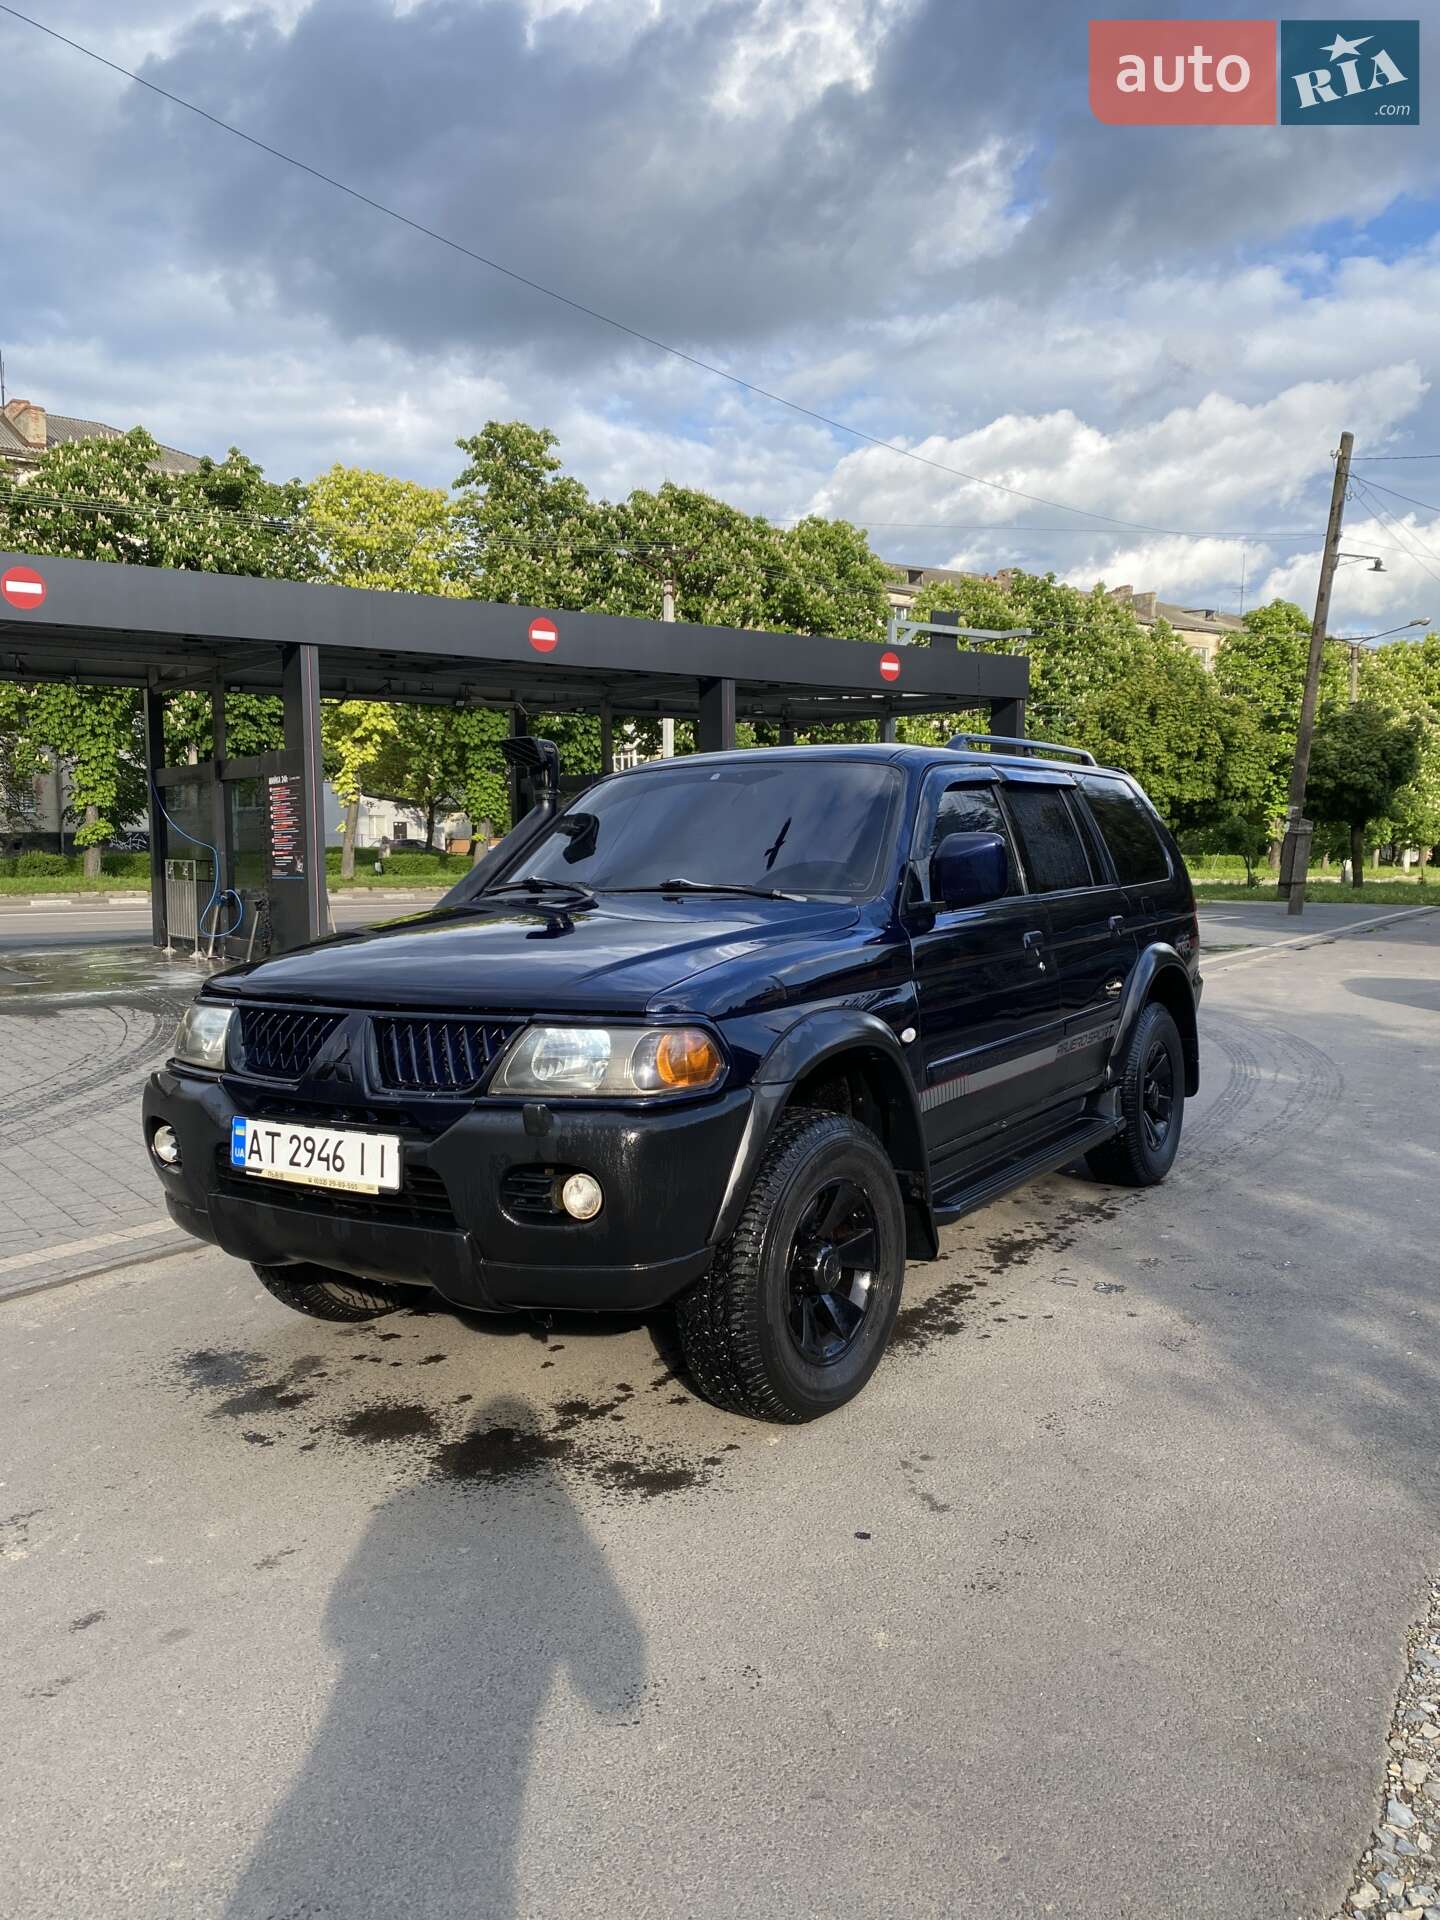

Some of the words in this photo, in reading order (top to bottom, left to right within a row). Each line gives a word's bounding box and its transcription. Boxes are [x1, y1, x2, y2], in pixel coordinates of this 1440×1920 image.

[234, 1147, 245, 1158] UA
[248, 1129, 281, 1163] AT
[289, 1134, 345, 1173] 2946
